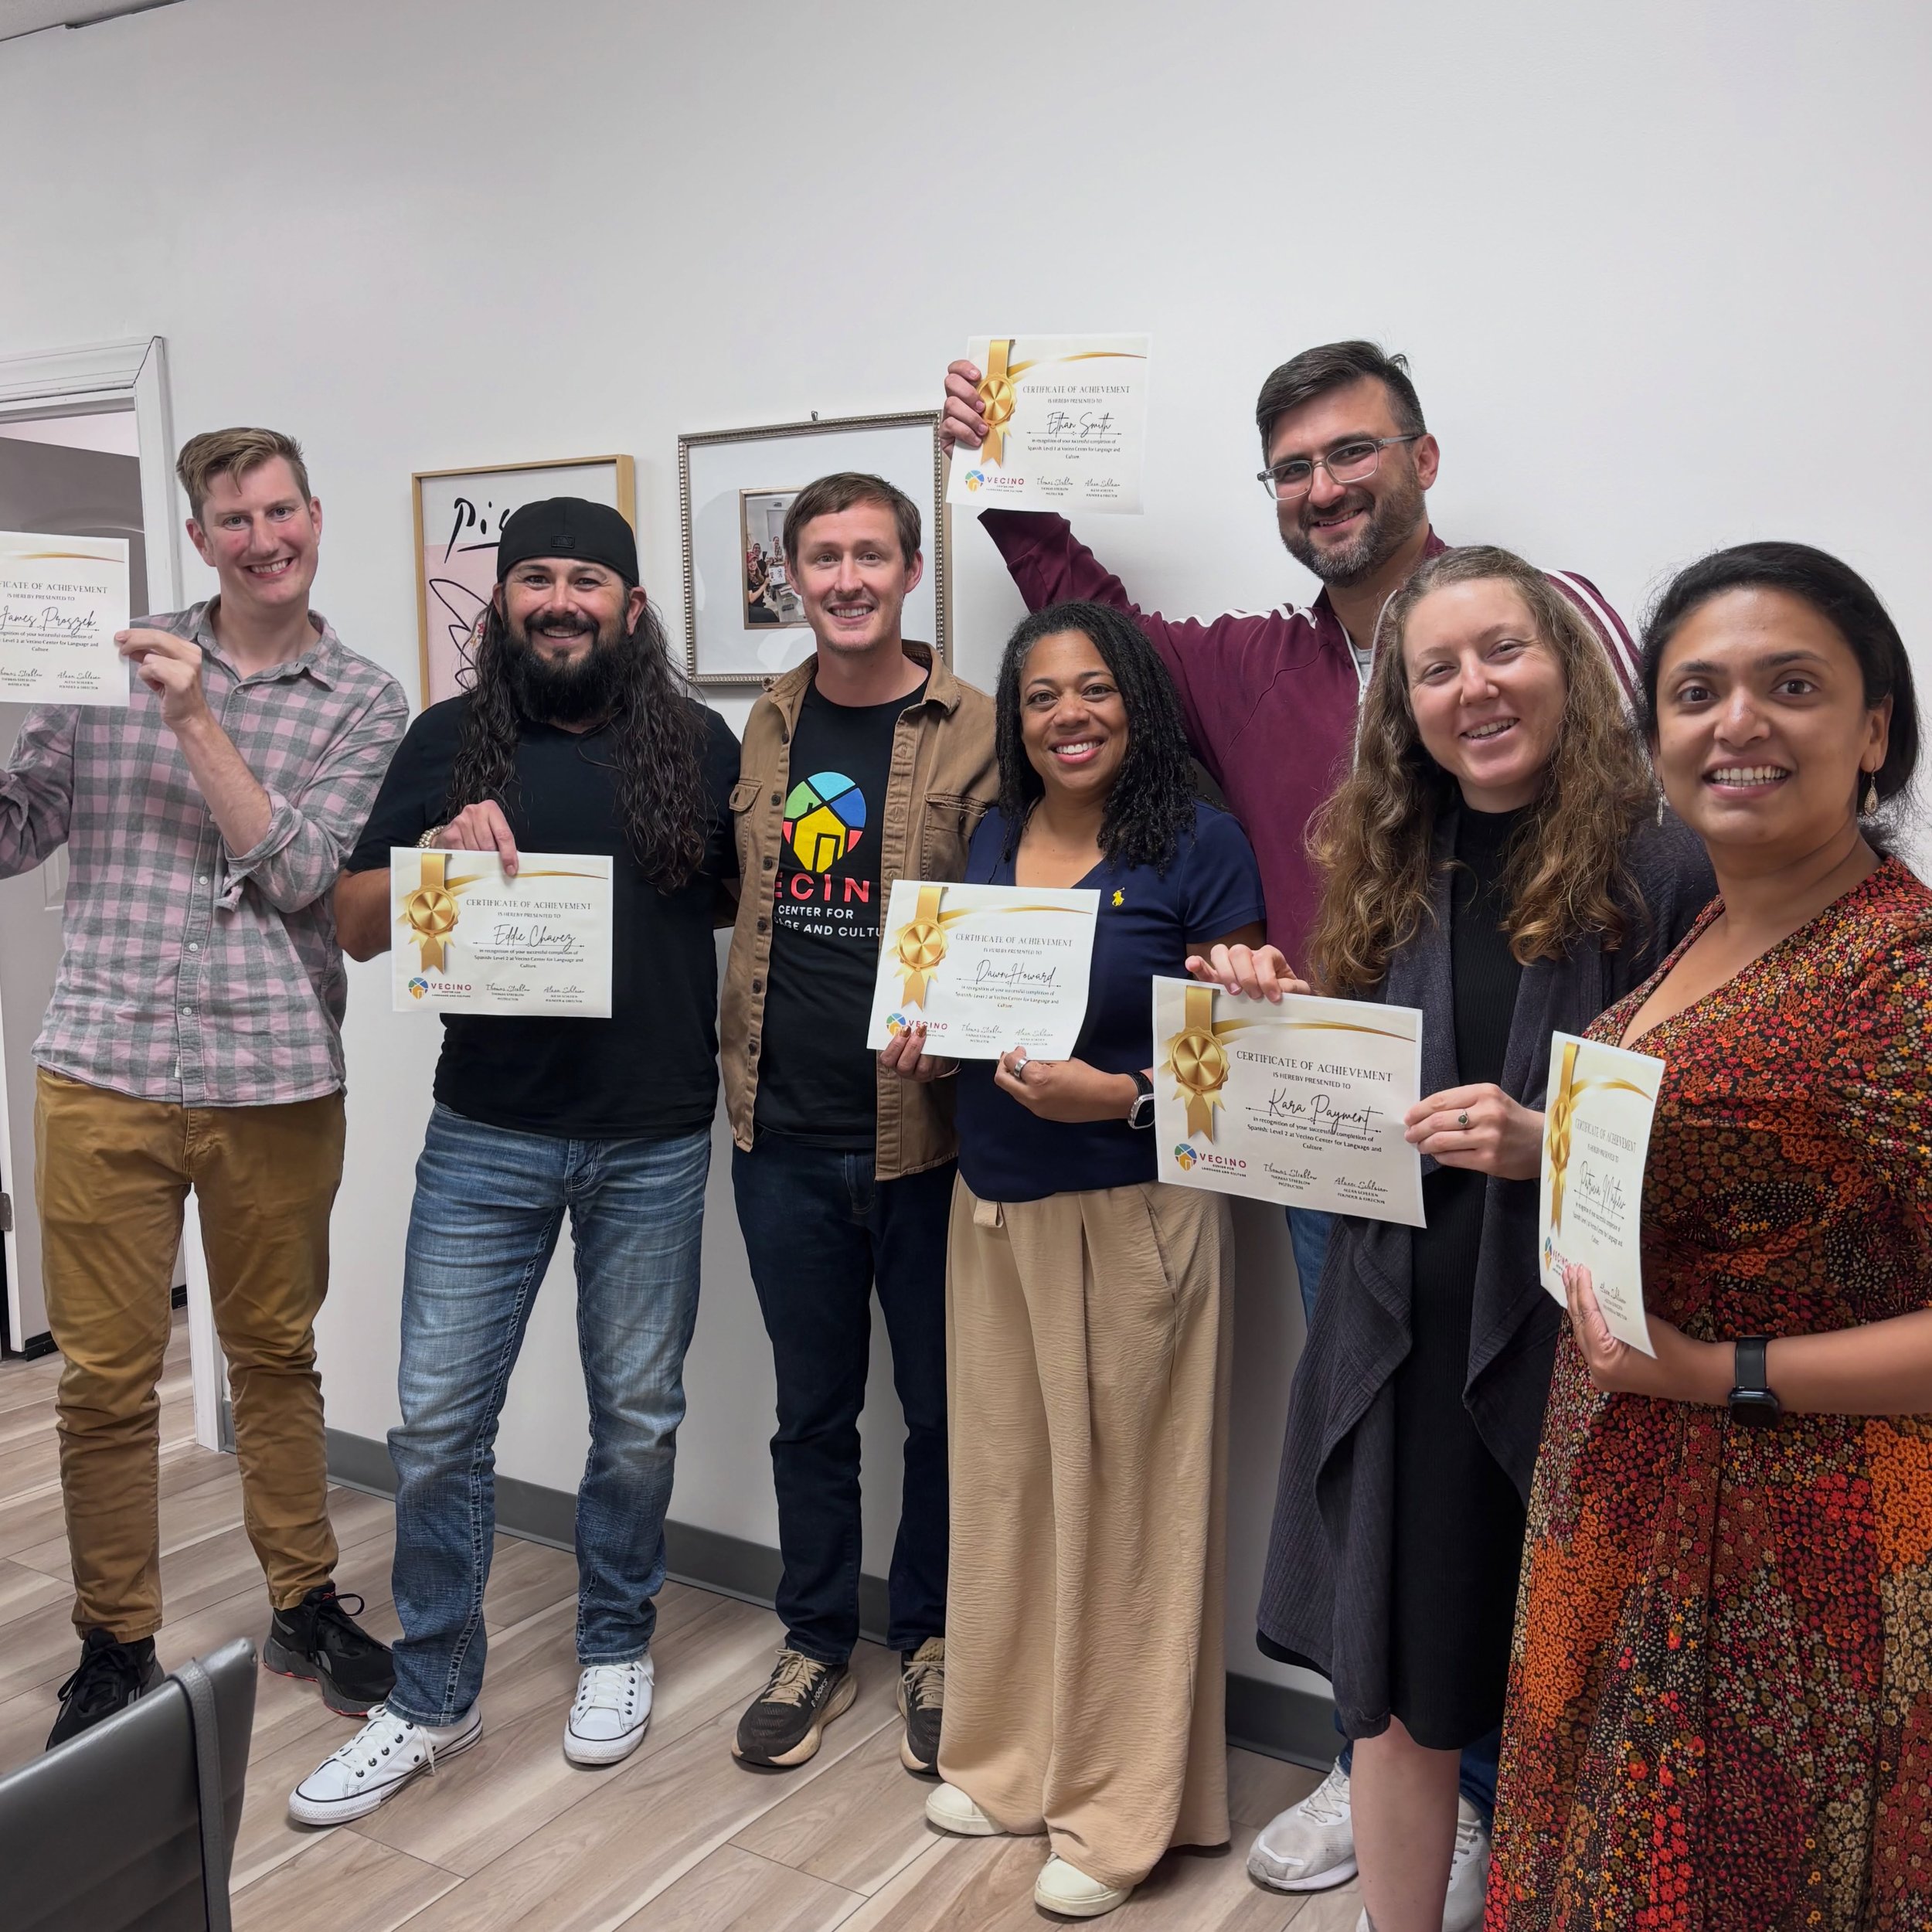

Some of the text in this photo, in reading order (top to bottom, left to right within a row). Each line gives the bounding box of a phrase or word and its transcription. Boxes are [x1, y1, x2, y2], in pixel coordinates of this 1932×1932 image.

[1046, 411, 1115, 438] Ethan Smith
[987, 477, 1025, 485] VECINO
[46, 583, 107, 594] ACHIEVEMENT
[0, 605, 37, 630] James
[466, 899, 519, 907] CERTIFICATE
[778, 905, 854, 919] CENTER FOR
[494, 923, 577, 952] Eddie Chavez
[803, 924, 833, 935] AND
[955, 933, 1004, 944] CERTIFICATE
[1019, 937, 1073, 947] ACHIEVEMENT
[976, 959, 1056, 988] Dawn Howard
[1236, 1050, 1393, 1082] CERTIFICATE OF ACHIEVEMENT
[1280, 1073, 1304, 1082] HEREBY
[1304, 1077, 1341, 1088] PRESENTED
[1269, 1088, 1383, 1135] Kara Payment
[1260, 1118, 1287, 1127] recognition
[1336, 1131, 1366, 1141] completion
[1296, 1133, 1314, 1141] Vecino
[1315, 1136, 1333, 1145] Center
[1344, 1141, 1370, 1151] Language
[1199, 1153, 1247, 1168] VECINO
